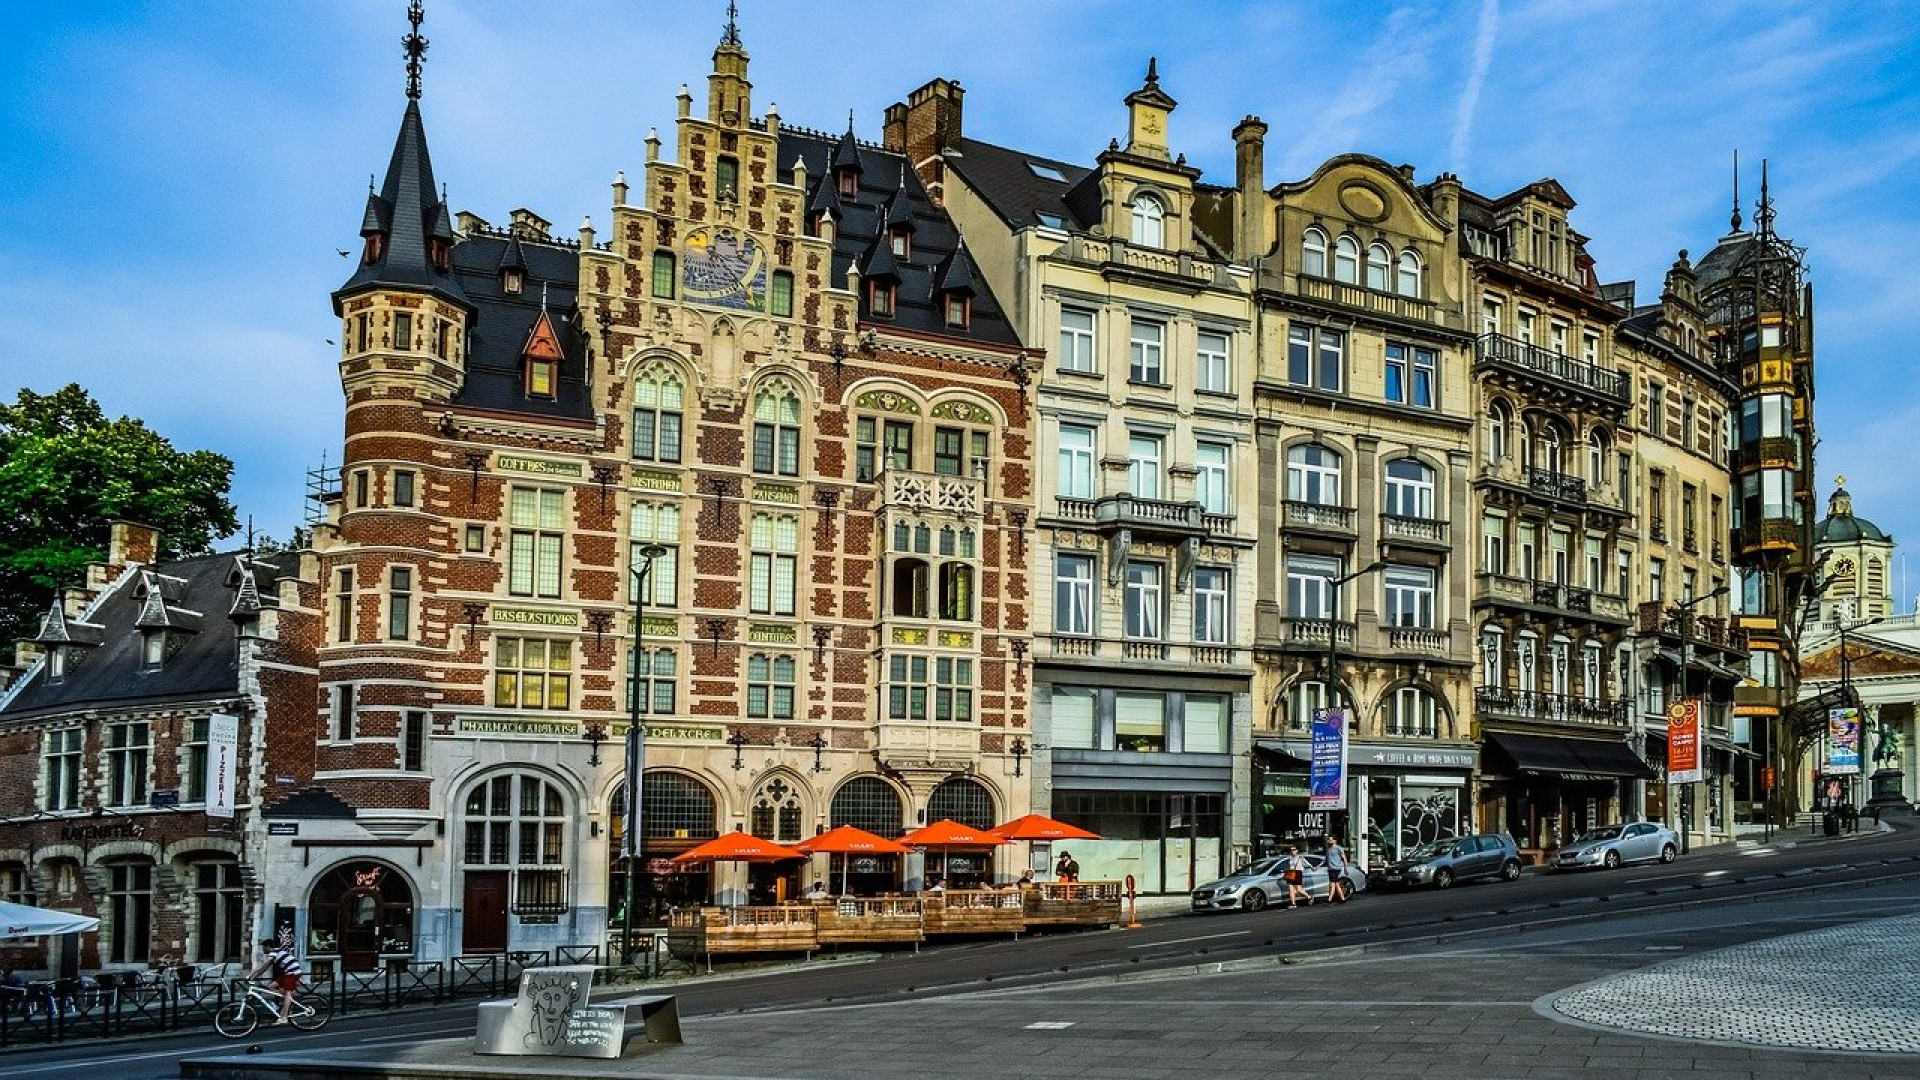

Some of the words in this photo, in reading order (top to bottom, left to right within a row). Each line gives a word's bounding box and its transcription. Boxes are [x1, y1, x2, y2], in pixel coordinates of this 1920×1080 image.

[500, 458, 546, 472] COFFRES
[217, 745, 228, 807] PIZZERIA
[1298, 812, 1324, 828] LOVE
